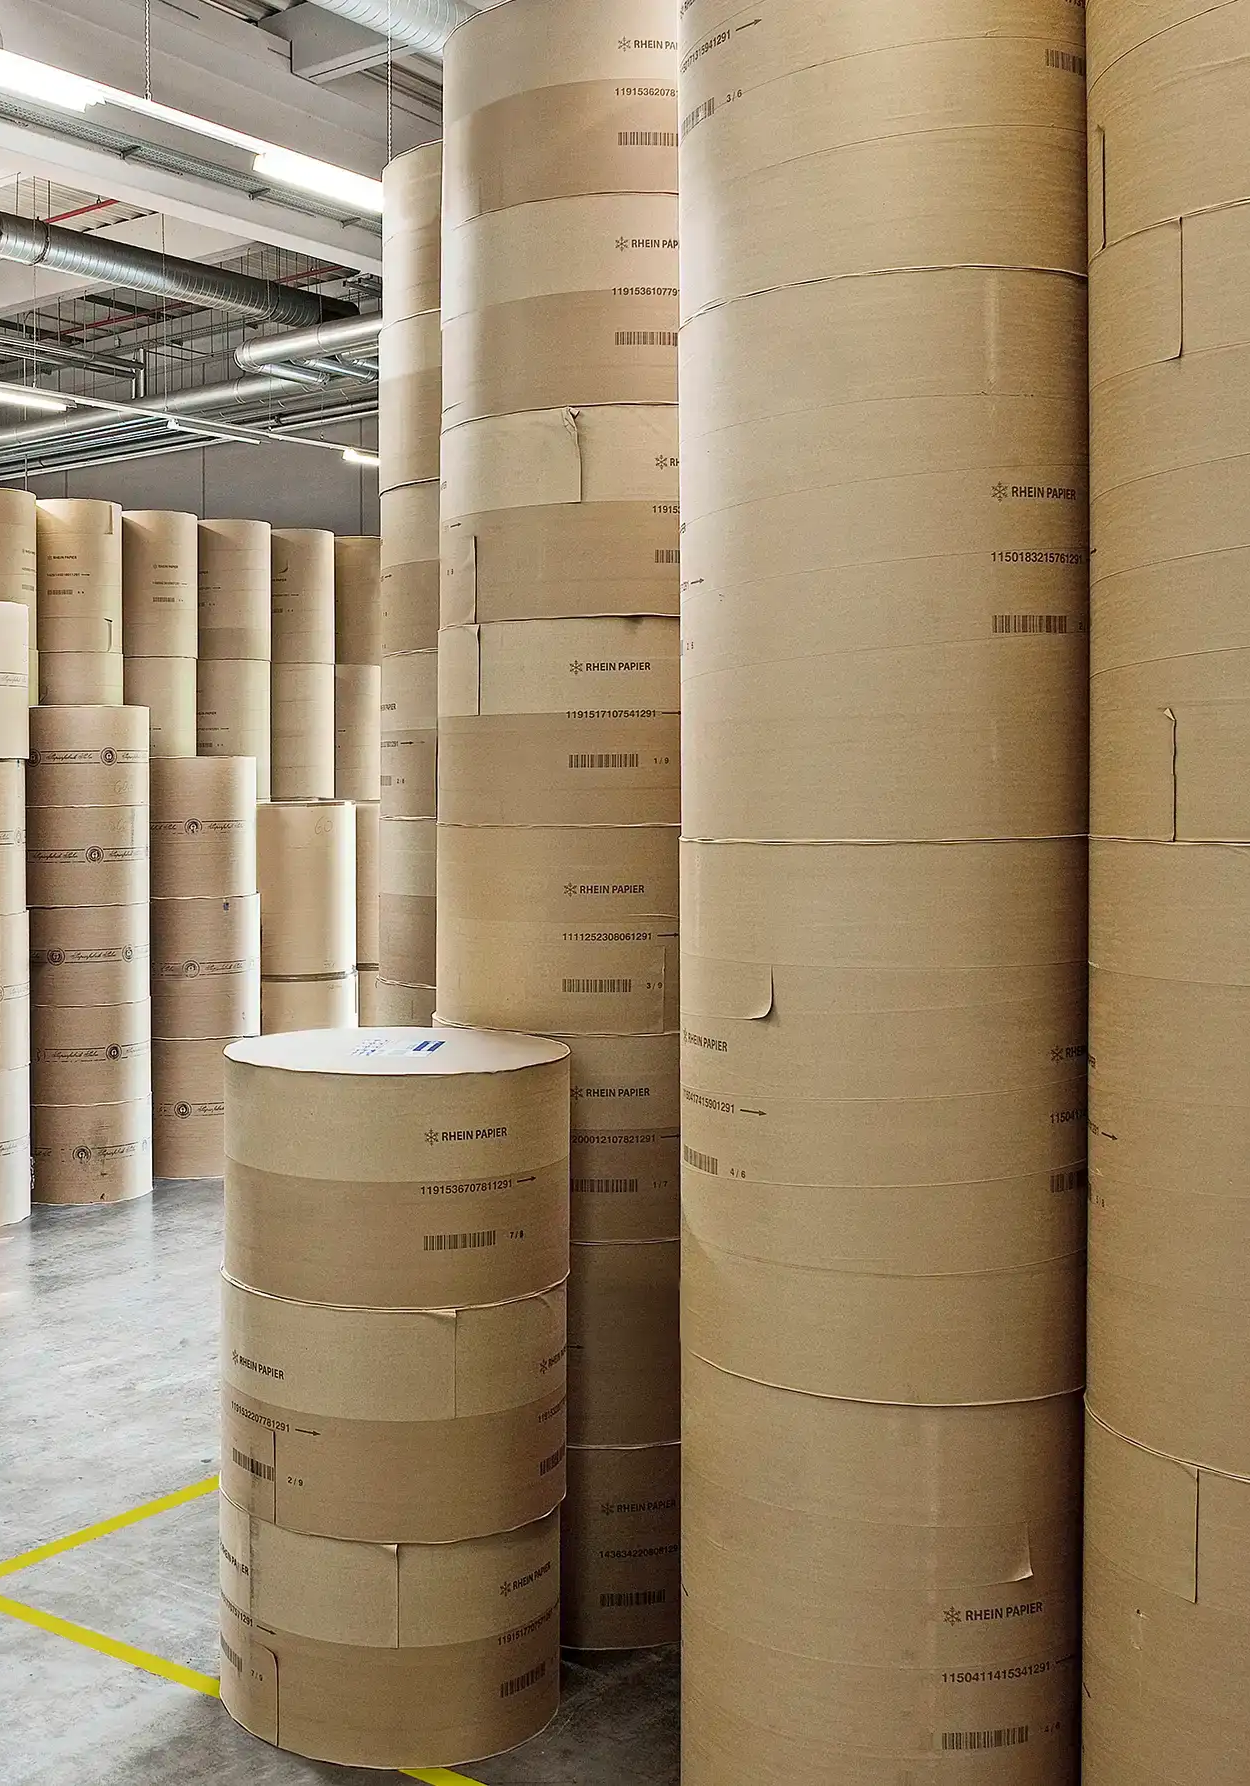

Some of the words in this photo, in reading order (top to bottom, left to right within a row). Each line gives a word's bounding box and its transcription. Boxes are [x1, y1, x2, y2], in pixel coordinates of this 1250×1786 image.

[633, 39, 663, 50] RHEIN
[631, 239, 660, 249] RHEIN
[612, 287, 680, 297] 119153610779
[1011, 486, 1045, 499] RHEIN
[1046, 487, 1077, 501] PAPIER
[585, 662, 616, 672] RHEIN
[618, 661, 651, 671] PAPIER
[579, 885, 610, 894] RHEIN
[611, 884, 645, 894] PAPIER
[703, 1037, 728, 1053] PAPIER
[585, 1088, 616, 1098] RHEIN
[617, 1087, 650, 1097] PAPIER
[441, 1130, 474, 1142] RHEIN
[475, 1126, 508, 1140] PAPIER
[239, 1355, 258, 1372] RHEIN
[258, 1363, 285, 1381] PAPIER
[616, 1502, 647, 1513] RHEIN
[647, 1500, 677, 1511] PAPIER
[512, 1573, 534, 1592] RHEIN
[965, 1608, 1004, 1622] RHEIN
[1005, 1601, 1044, 1618] PAPIER
